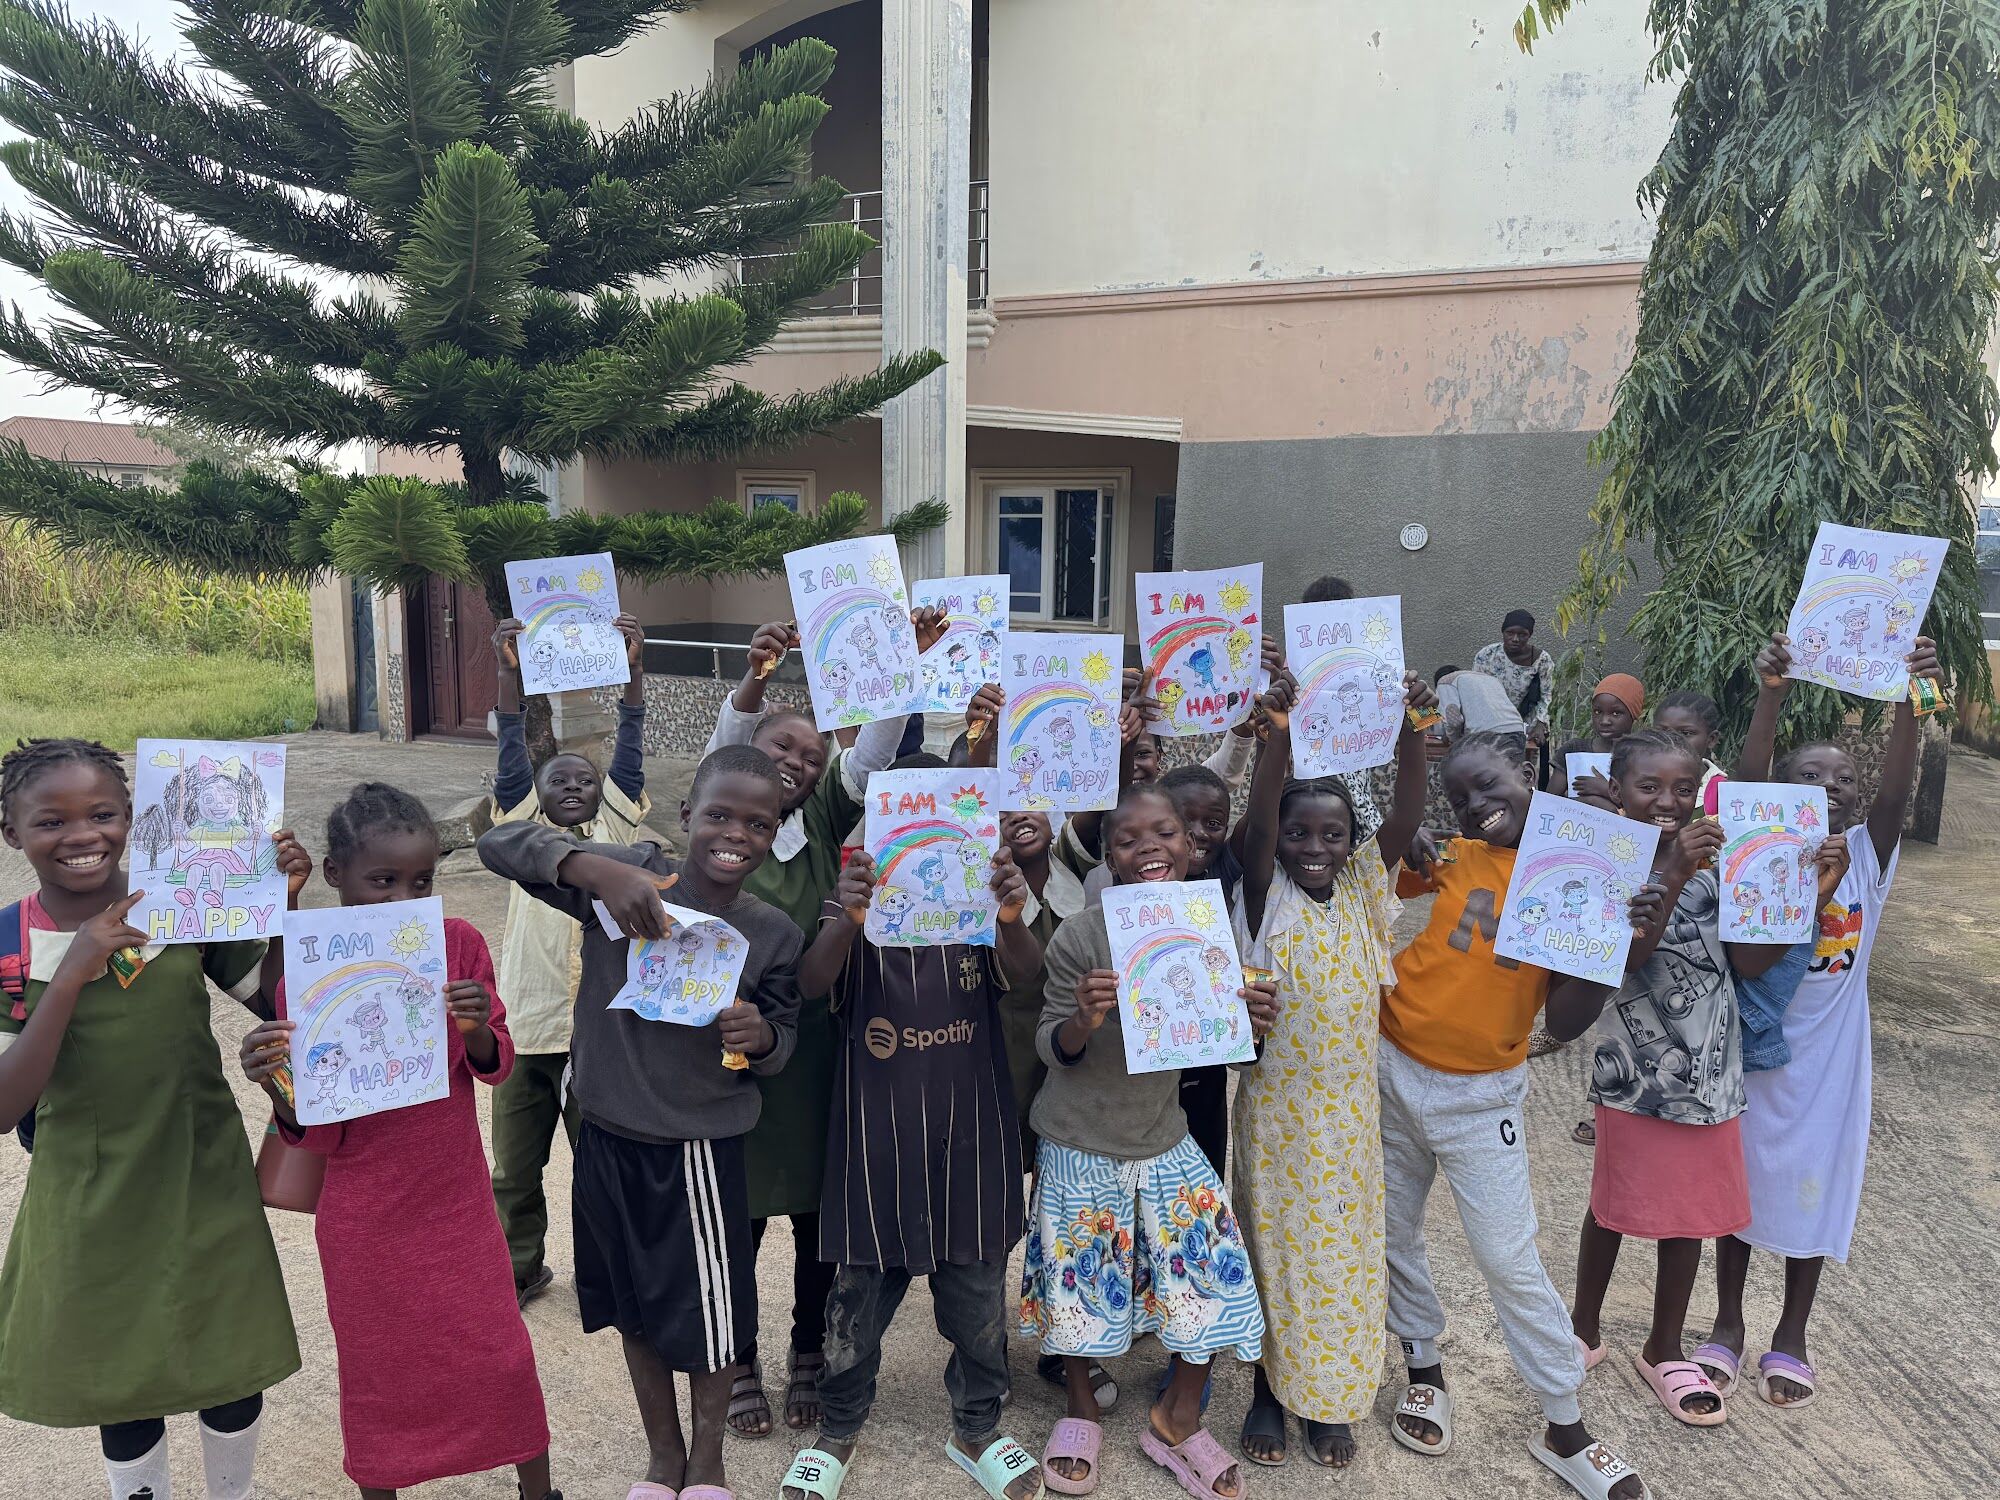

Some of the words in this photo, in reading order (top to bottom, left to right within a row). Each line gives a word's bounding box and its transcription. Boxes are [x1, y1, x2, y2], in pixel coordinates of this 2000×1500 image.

[1819, 544, 1836, 565] I
[1837, 549, 1878, 573] AM
[517, 577, 532, 594] I
[536, 576, 567, 593] AM
[798, 569, 818, 594] I
[821, 563, 858, 589] AM
[1148, 593, 1165, 616] I
[1169, 593, 1206, 614] AM
[1296, 625, 1313, 648] I
[1317, 623, 1352, 646] AM
[560, 652, 617, 676] HAPPY
[1012, 654, 1028, 677] I
[1032, 655, 1069, 678] AM
[1826, 655, 1899, 682] HAPPY
[855, 670, 915, 703] HAPPY
[937, 681, 984, 699] HAP
[1186, 688, 1250, 718] HAPPY
[1331, 725, 1394, 755] HAPPY
[1042, 769, 1109, 792] HAPPY
[877, 791, 893, 816] I
[897, 791, 937, 816] AM
[1730, 800, 1746, 821] I
[1750, 801, 1785, 823] AM
[1538, 813, 1555, 836] I
[1557, 819, 1595, 847] AM
[148, 904, 275, 940] HAPPY
[913, 909, 987, 932] HAPPY
[1116, 906, 1134, 930] I
[1139, 904, 1175, 927] AM
[1761, 905, 1810, 926] HAPPY
[299, 935, 320, 963] I
[327, 932, 374, 961] AM
[1544, 927, 1617, 963] HAPPY
[902, 1018, 975, 1051] Spotify
[1170, 1016, 1239, 1046] HAPPY
[349, 1052, 434, 1094] HAPPY
[1500, 1119, 1516, 1146] C
